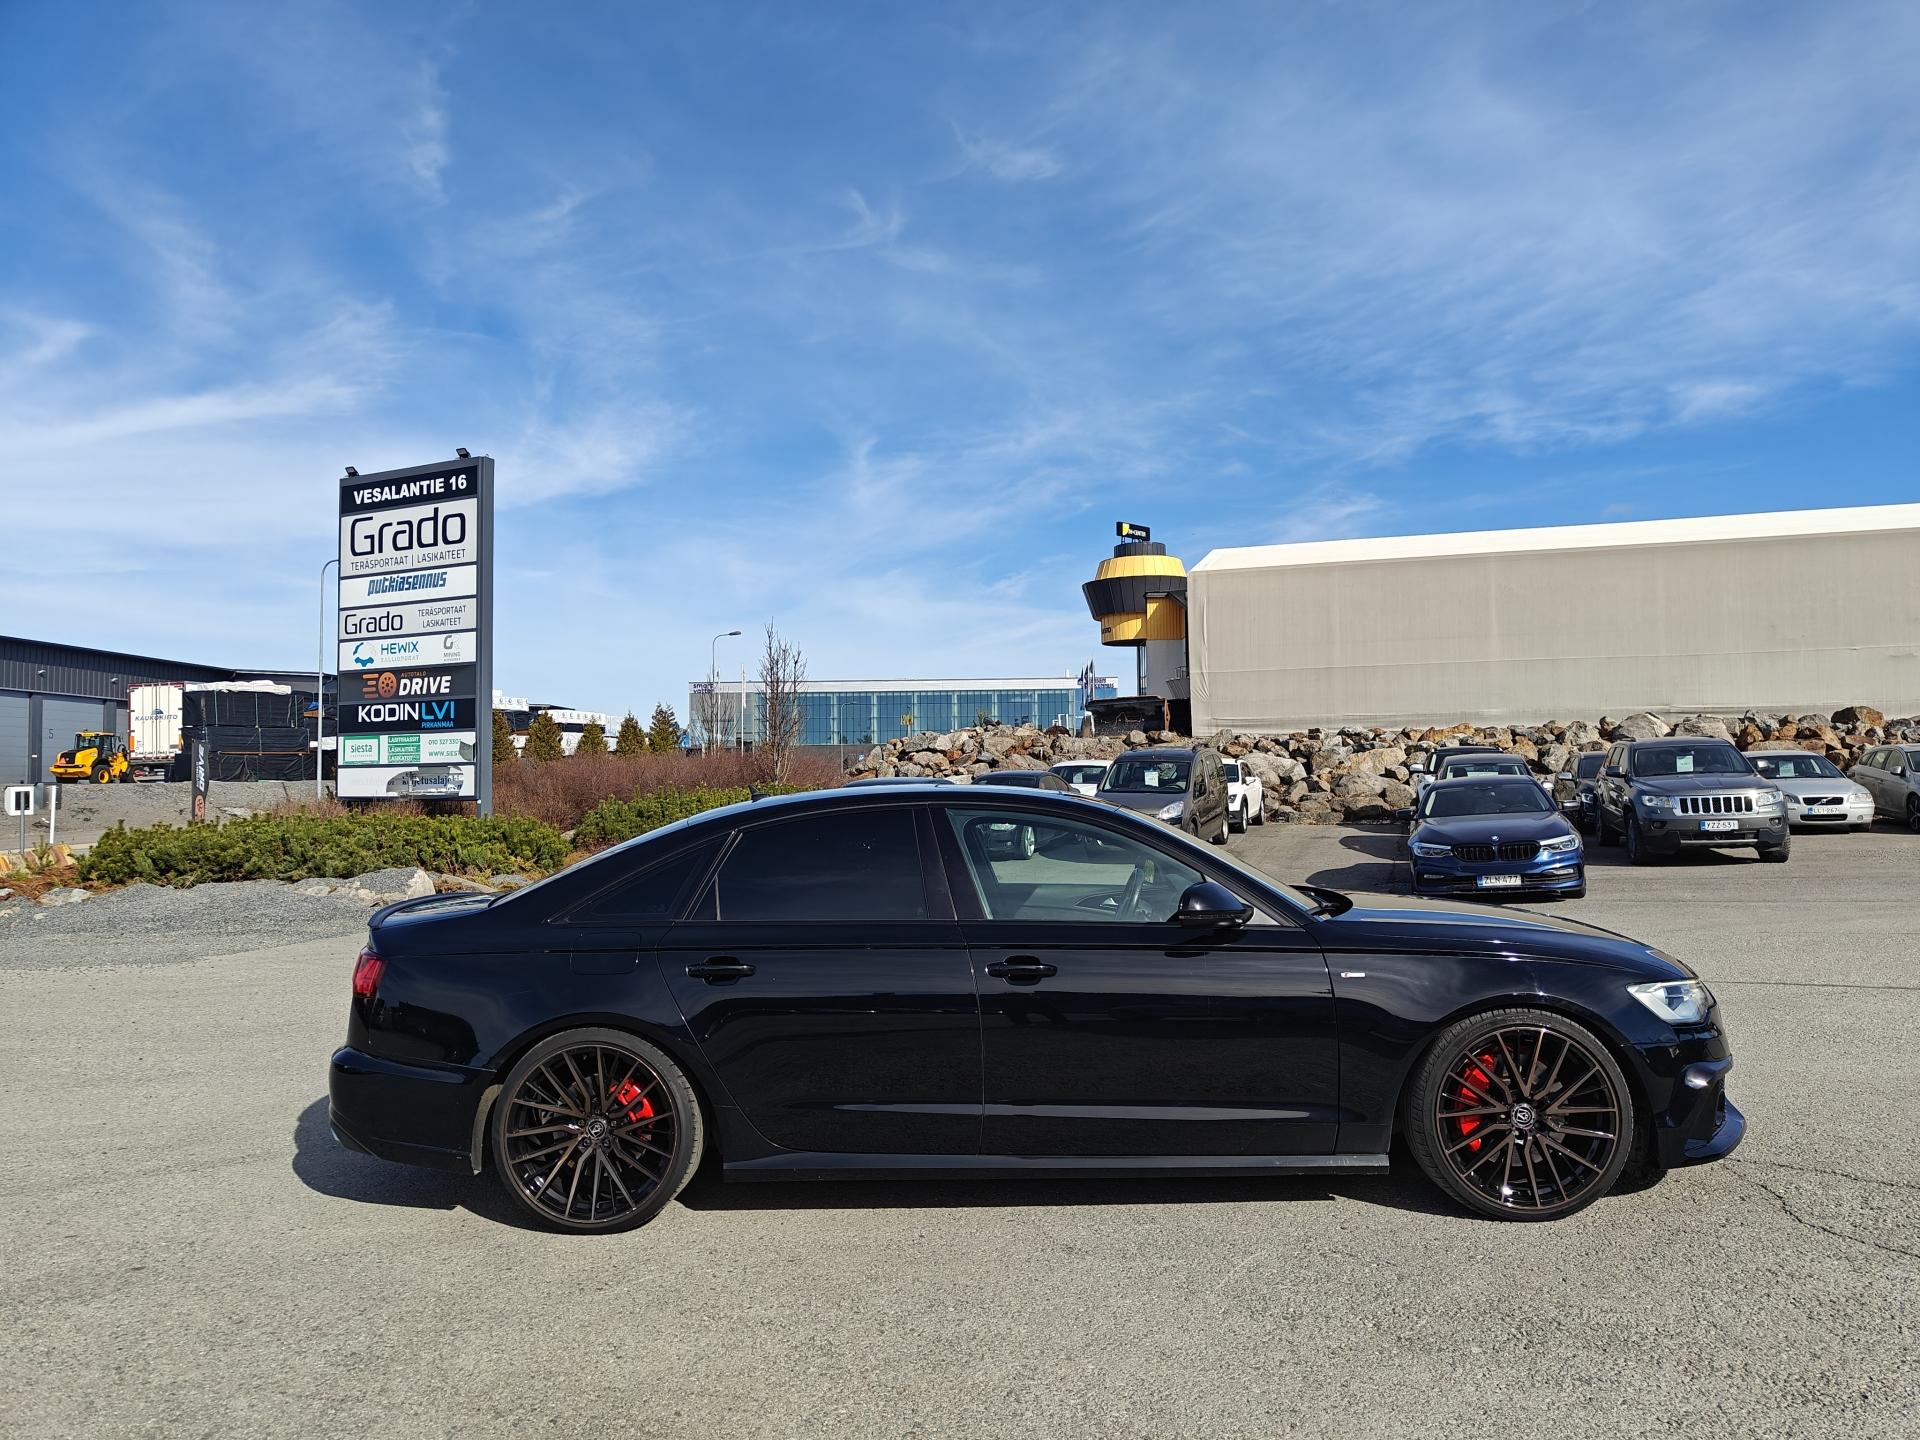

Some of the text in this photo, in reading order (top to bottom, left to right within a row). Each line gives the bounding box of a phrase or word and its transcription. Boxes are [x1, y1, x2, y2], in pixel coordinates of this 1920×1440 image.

[353, 474, 467, 504] VESALANTIE 16
[350, 507, 466, 557] Grado
[351, 549, 466, 571] TERÄSPORTAAT LASIKAITEET
[367, 571, 448, 596] putkiasennus
[344, 611, 403, 635] Grado
[422, 617, 461, 628] LASIKAITEET
[381, 641, 419, 655] HEWIX
[399, 676, 452, 696] DRIVE
[421, 721, 454, 729] PIRKANMAA
[350, 743, 373, 753] siesta
